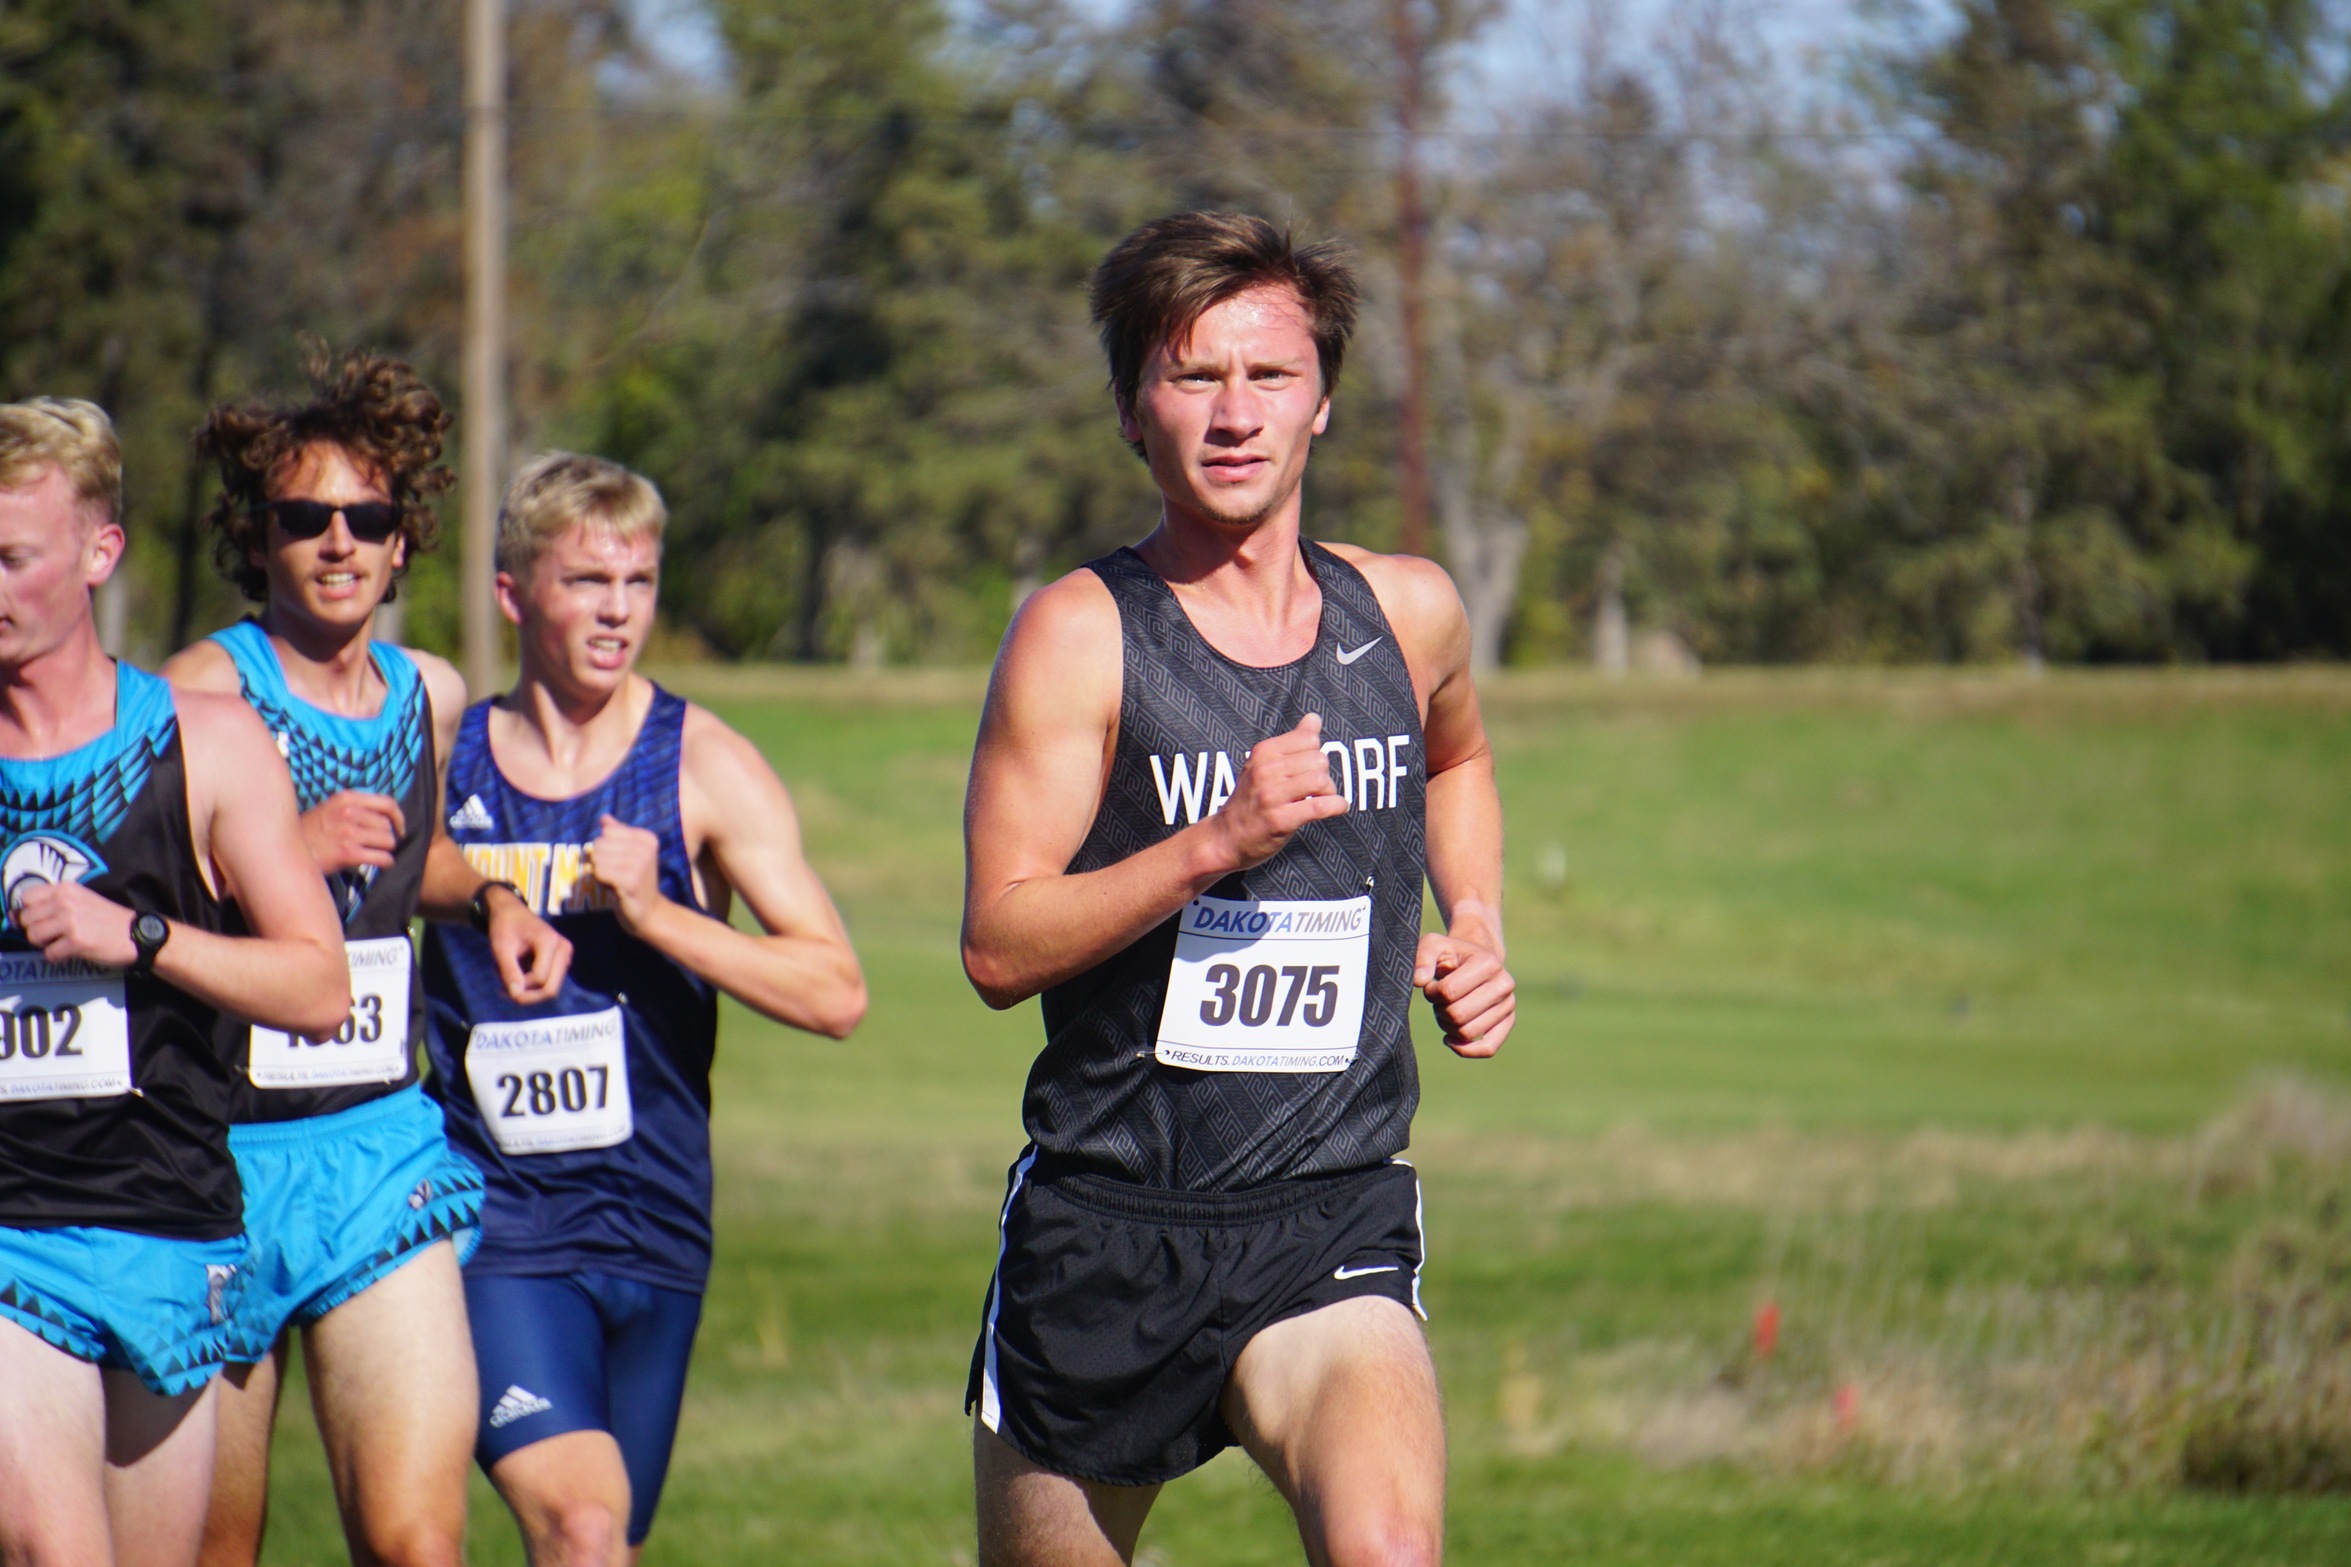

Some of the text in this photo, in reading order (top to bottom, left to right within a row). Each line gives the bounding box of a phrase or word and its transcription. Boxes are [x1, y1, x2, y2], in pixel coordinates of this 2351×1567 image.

[1150, 735, 1410, 826] WAORF
[1193, 906, 1362, 934] DAKOTATIMING
[287, 993, 383, 1048] 63
[1200, 963, 1340, 1028] 3075
[474, 1021, 617, 1050] DAKOTATIMING
[496, 1064, 609, 1118] 2807
